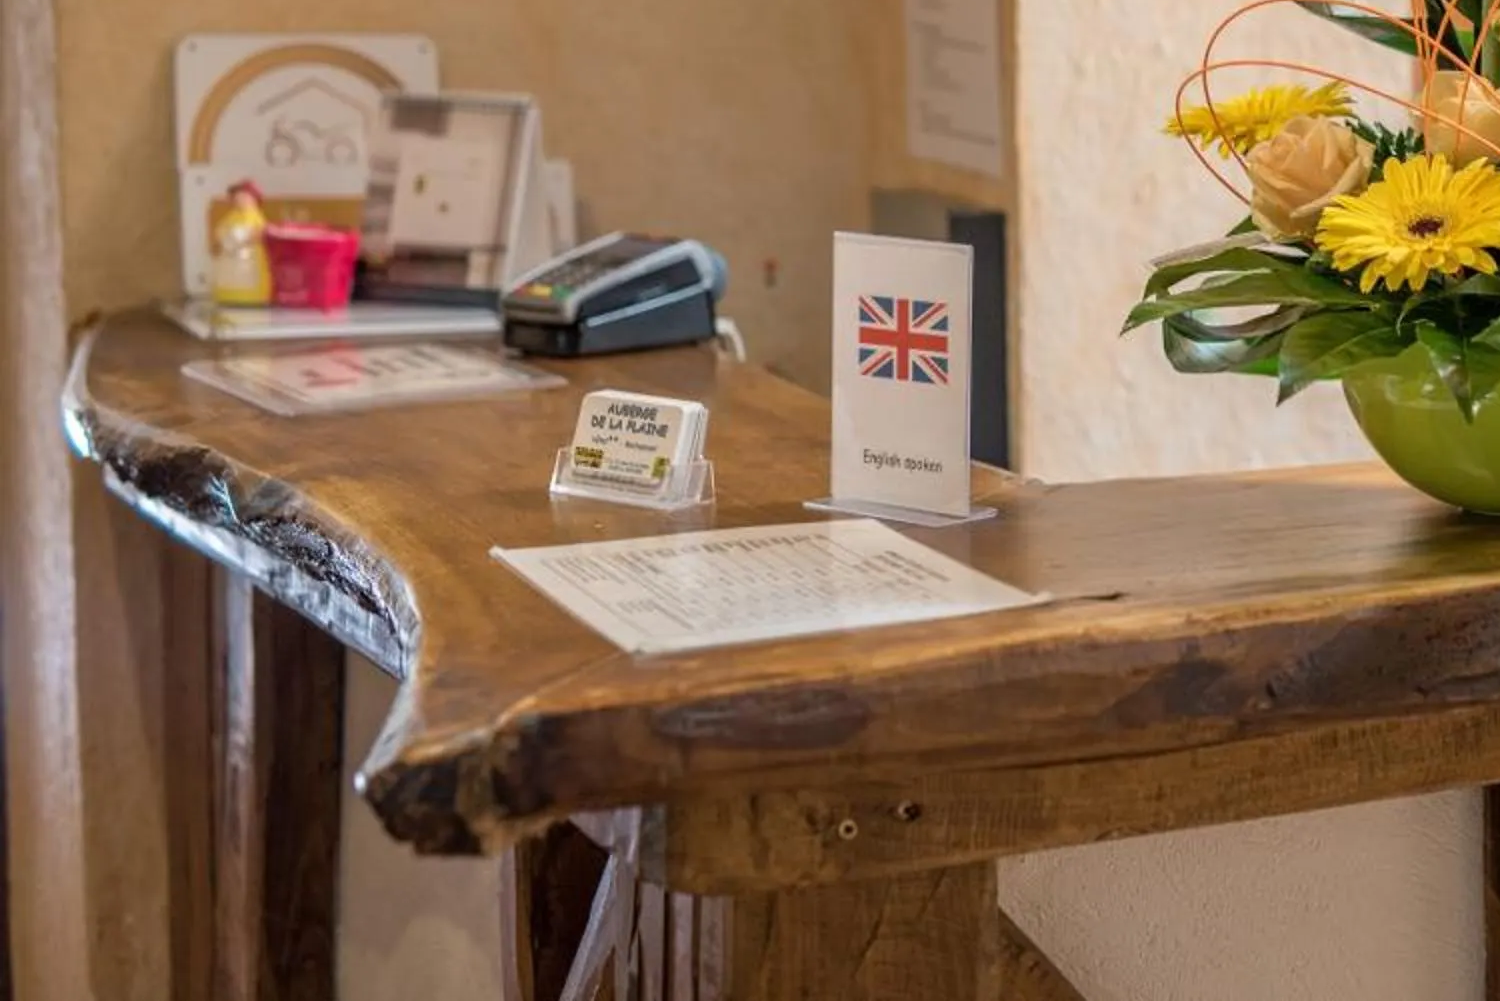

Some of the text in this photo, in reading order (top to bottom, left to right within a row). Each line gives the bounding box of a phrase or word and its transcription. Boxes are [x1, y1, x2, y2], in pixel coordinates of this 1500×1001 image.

[607, 402, 659, 421] AUBERGE
[591, 415, 669, 438] DE LA PLAINE
[863, 448, 943, 475] English spoken
